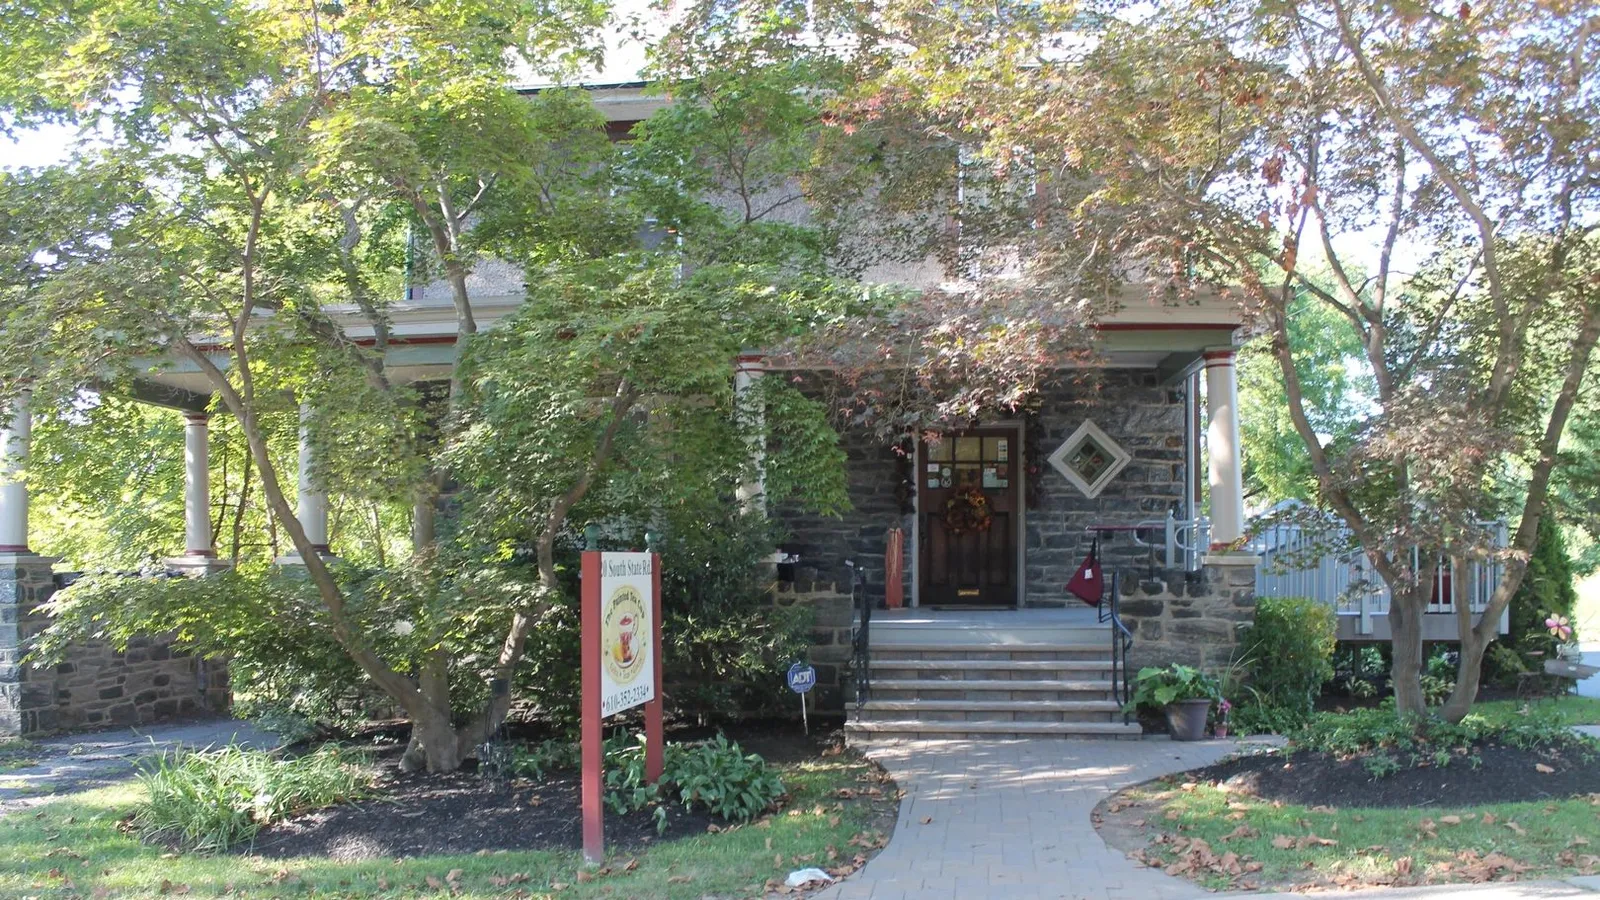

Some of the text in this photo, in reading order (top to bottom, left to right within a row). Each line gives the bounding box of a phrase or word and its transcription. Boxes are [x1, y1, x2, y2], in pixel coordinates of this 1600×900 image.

[609, 559, 627, 578] South
[628, 559, 642, 577] State
[612, 590, 630, 610] Painted
[792, 670, 812, 685] ADT
